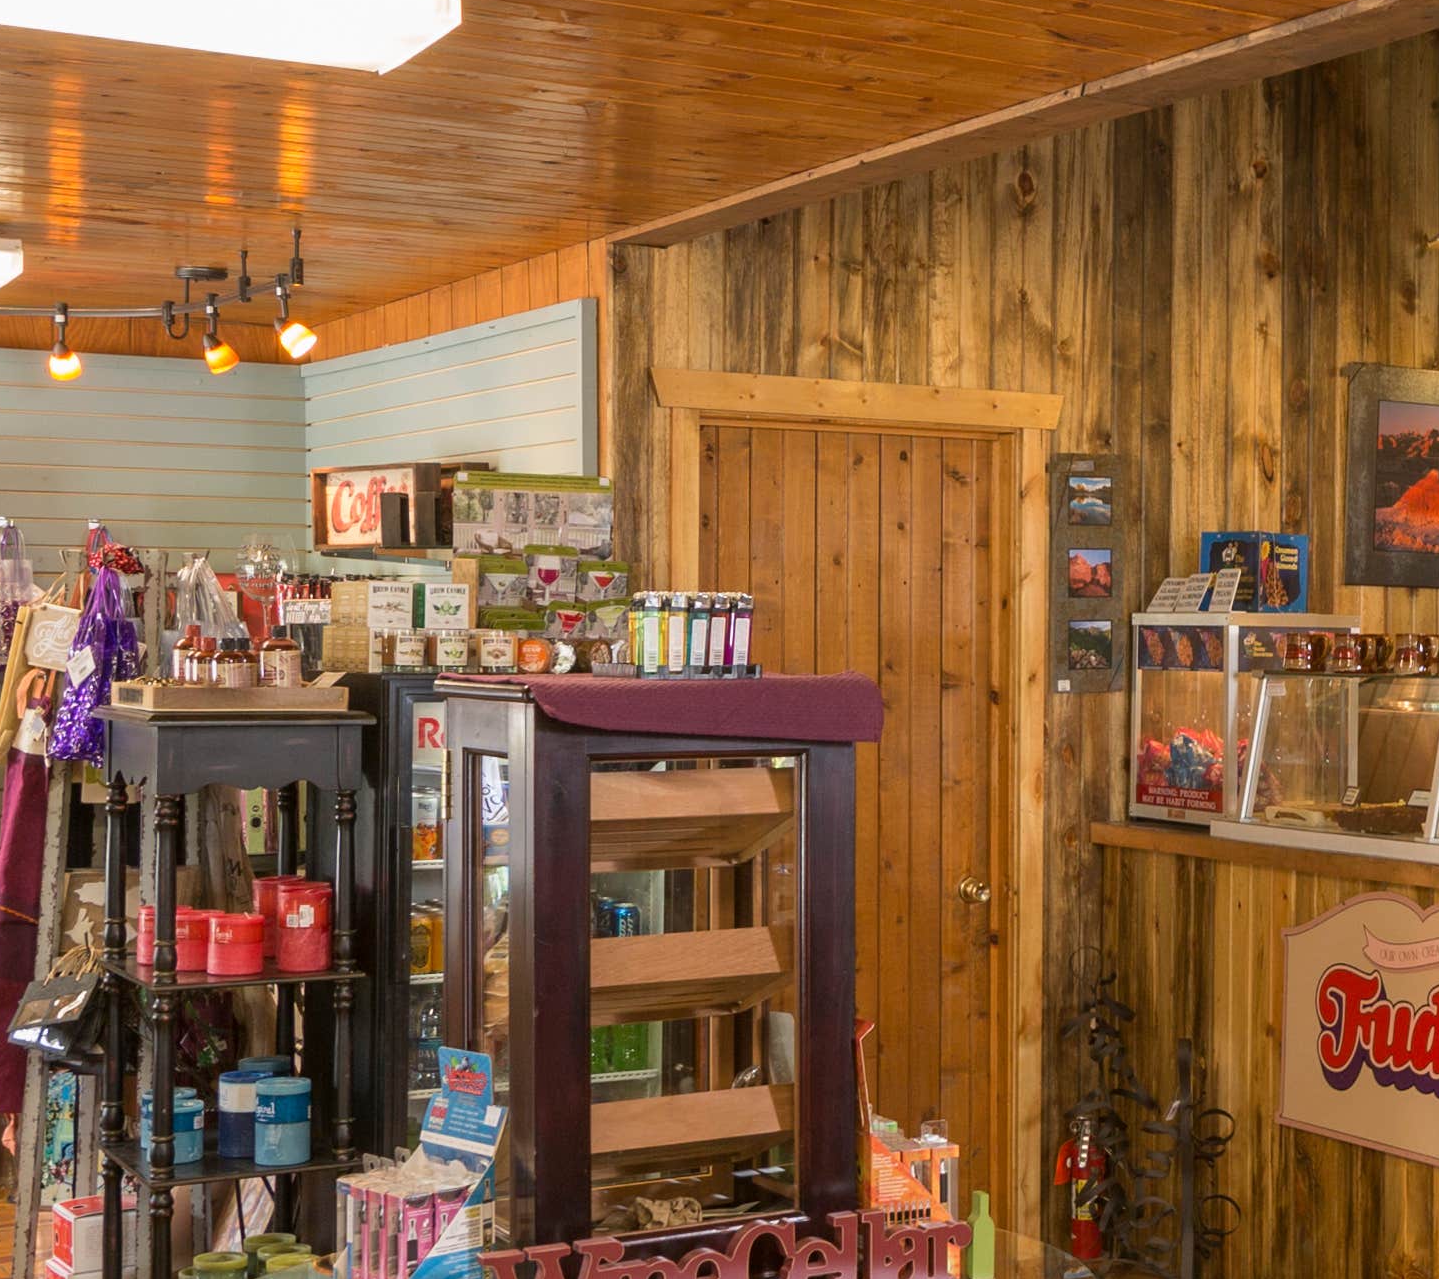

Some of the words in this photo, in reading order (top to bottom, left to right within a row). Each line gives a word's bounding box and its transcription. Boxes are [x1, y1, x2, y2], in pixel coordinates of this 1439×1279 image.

[1148, 786, 1177, 797] WARNING:
[1180, 789, 1209, 800] PRODUCT
[1142, 794, 1154, 803] MAY
[1156, 796, 1165, 804] BE
[1166, 797, 1185, 806] HABIT
[1186, 799, 1216, 810] FORMING
[1379, 949, 1395, 962] OUR
[1398, 948, 1418, 962] OWN
